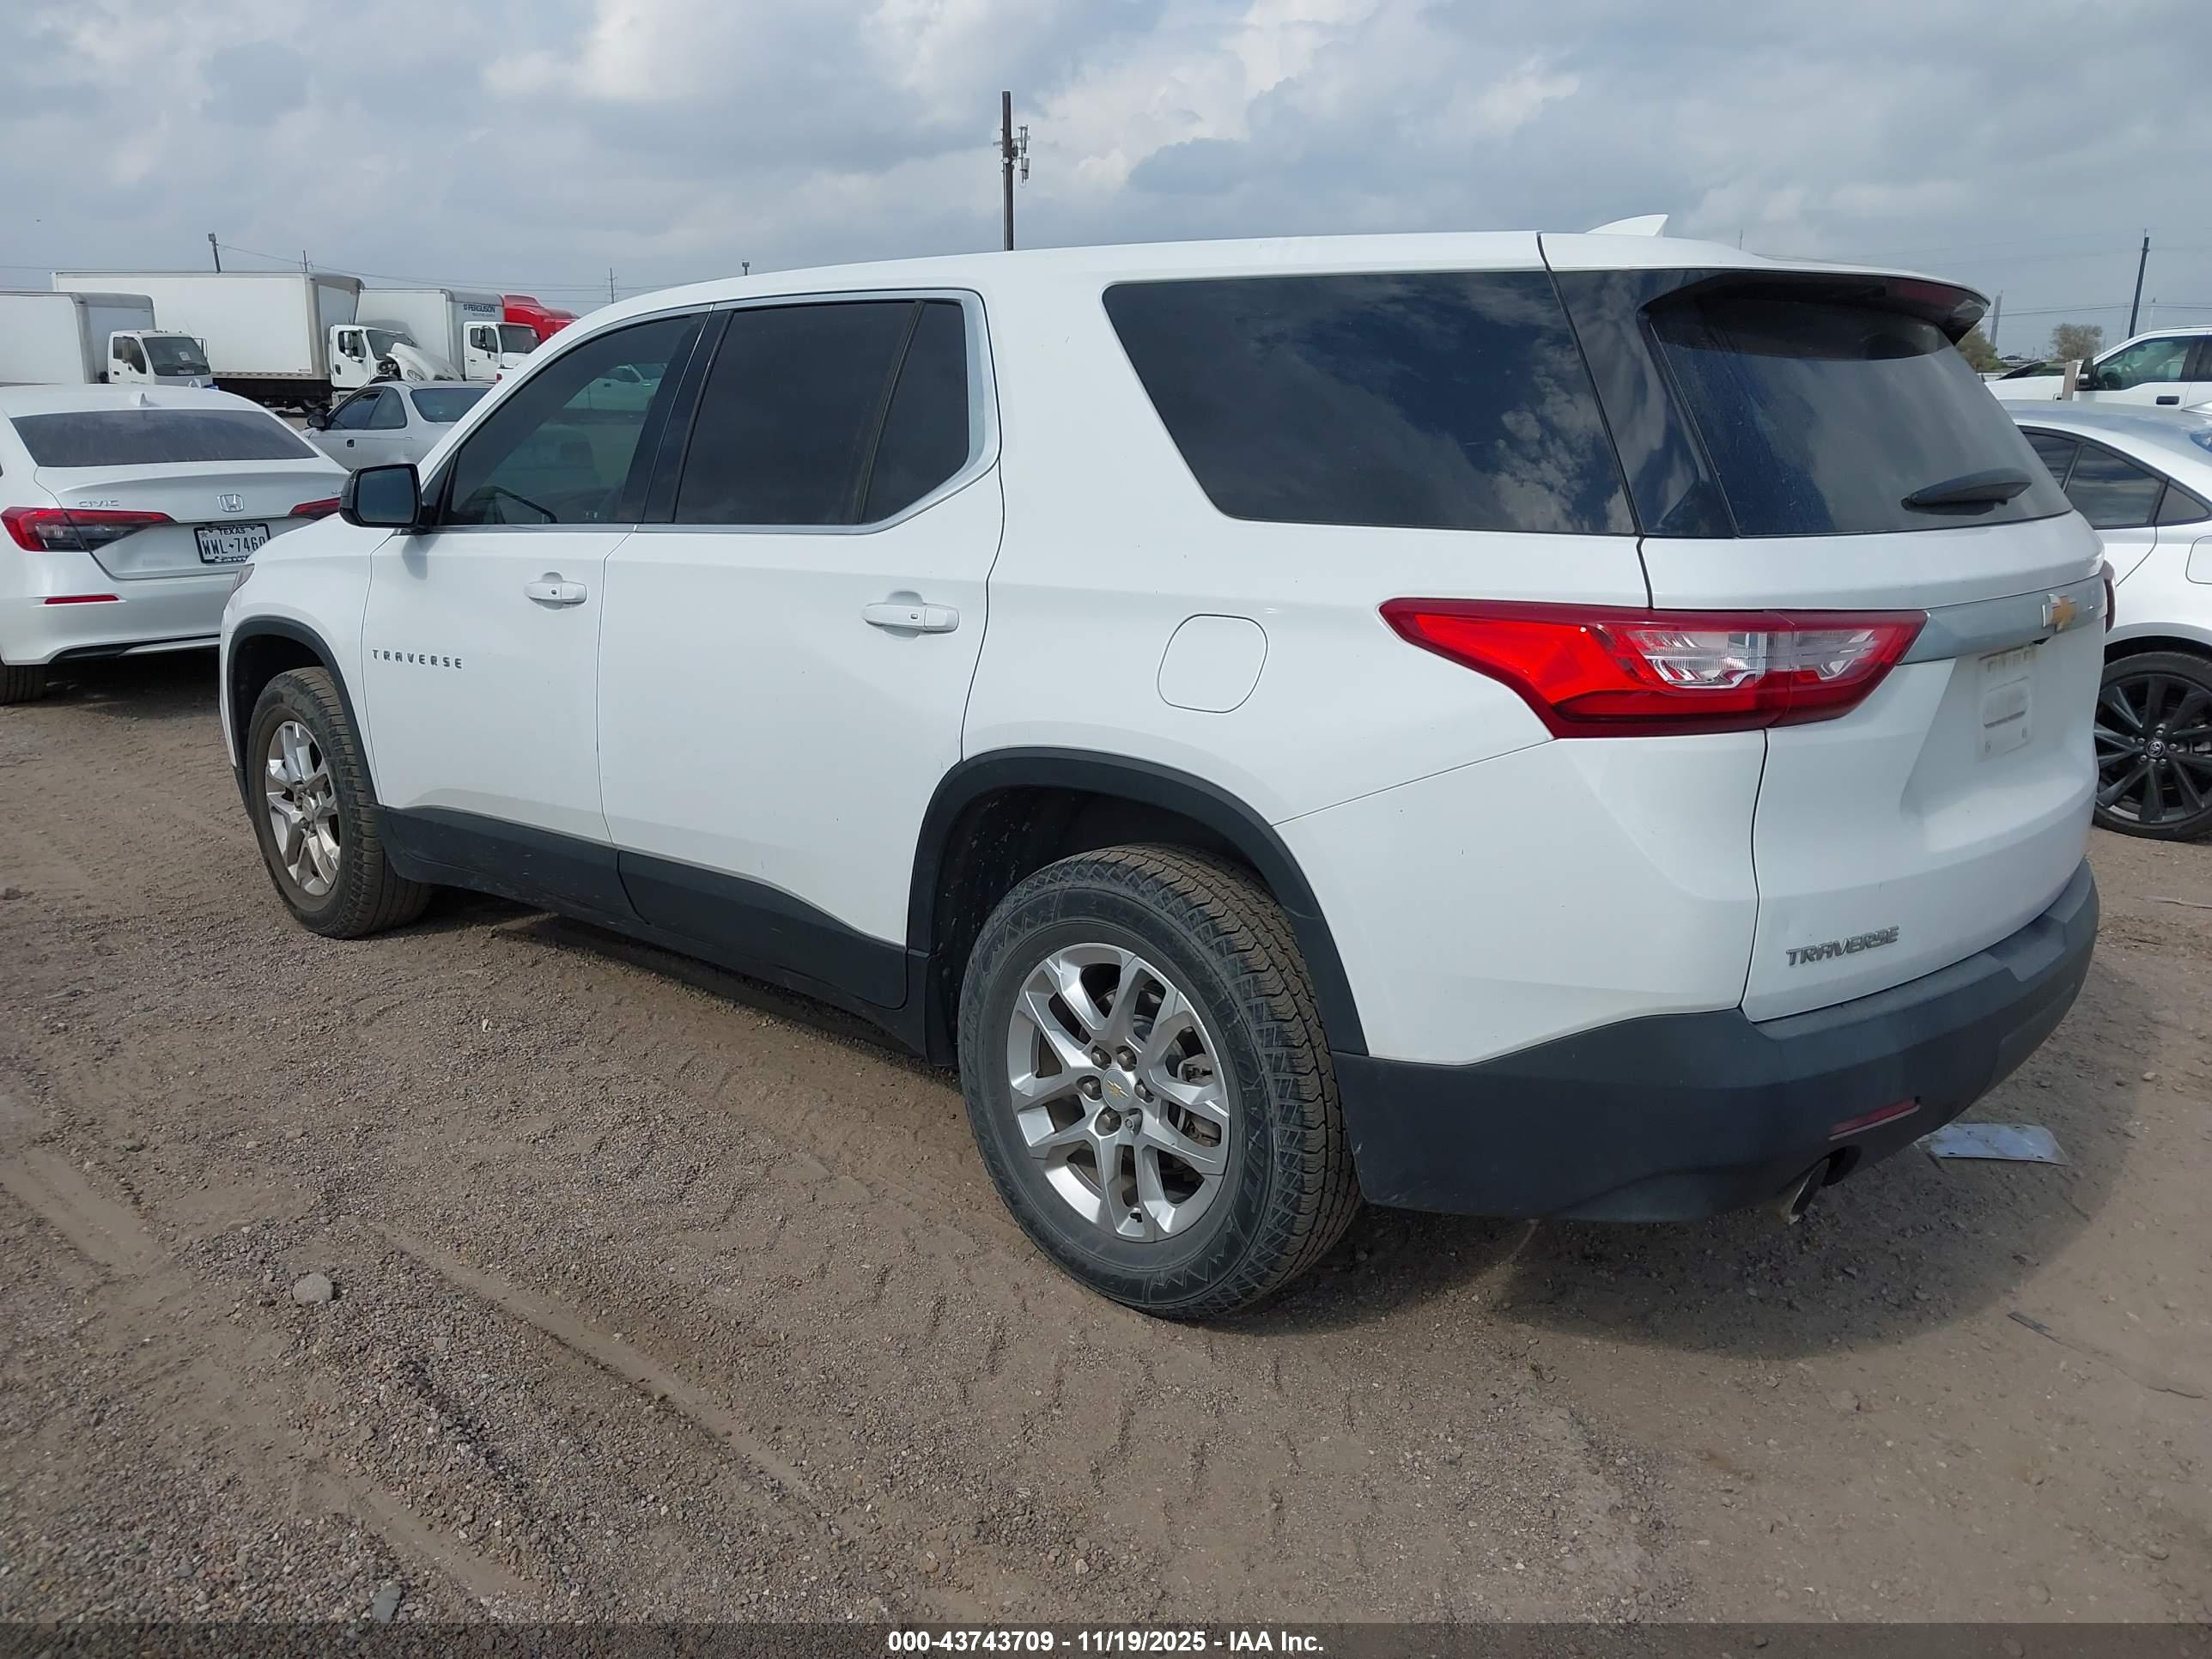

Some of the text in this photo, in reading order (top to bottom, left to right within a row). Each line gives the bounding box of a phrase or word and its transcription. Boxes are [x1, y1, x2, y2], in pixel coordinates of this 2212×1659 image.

[219, 526, 246, 536] TEXAS
[372, 649, 462, 669] TRAVERSE
[1785, 925, 1899, 966] TRAVERSE
